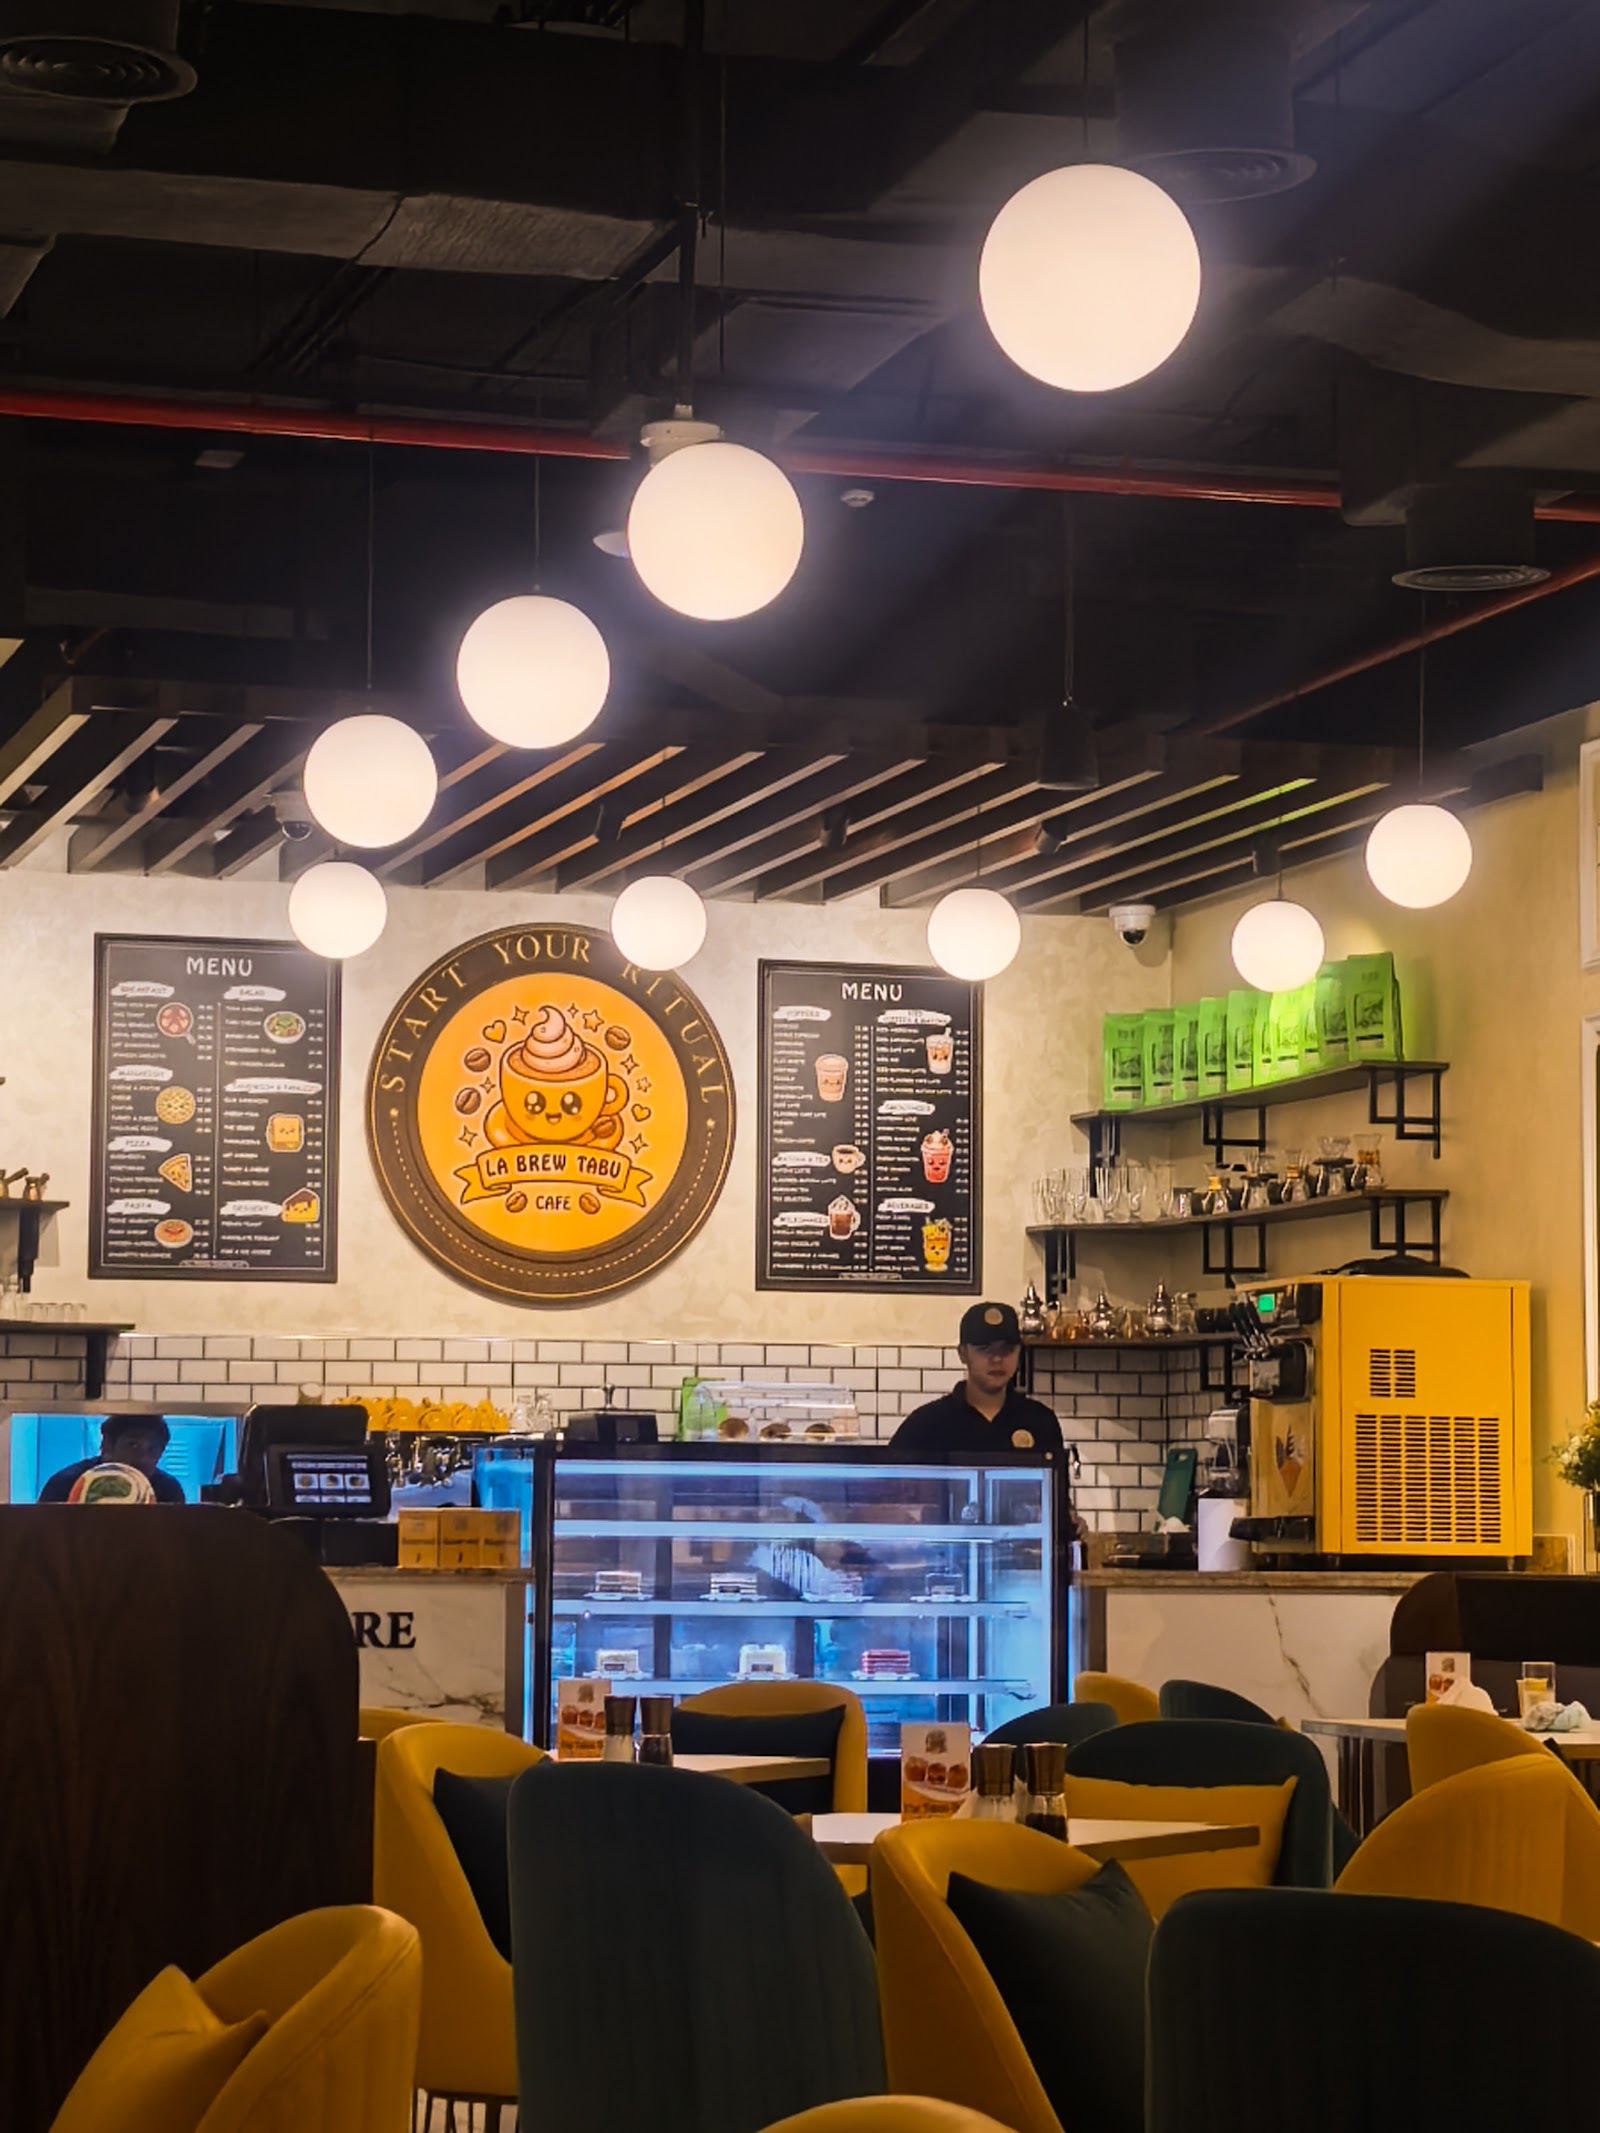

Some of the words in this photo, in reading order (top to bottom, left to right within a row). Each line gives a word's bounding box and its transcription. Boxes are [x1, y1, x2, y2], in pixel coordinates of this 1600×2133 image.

[186, 956, 252, 976] MENU
[841, 982, 902, 1001] MENU
[381, 962, 468, 1092] START
[492, 934, 591, 965] YOUR
[486, 1157, 508, 1177] LA
[516, 1154, 567, 1172] BREW
[577, 1155, 621, 1178] TABU
[535, 1195, 571, 1210] CAFE
